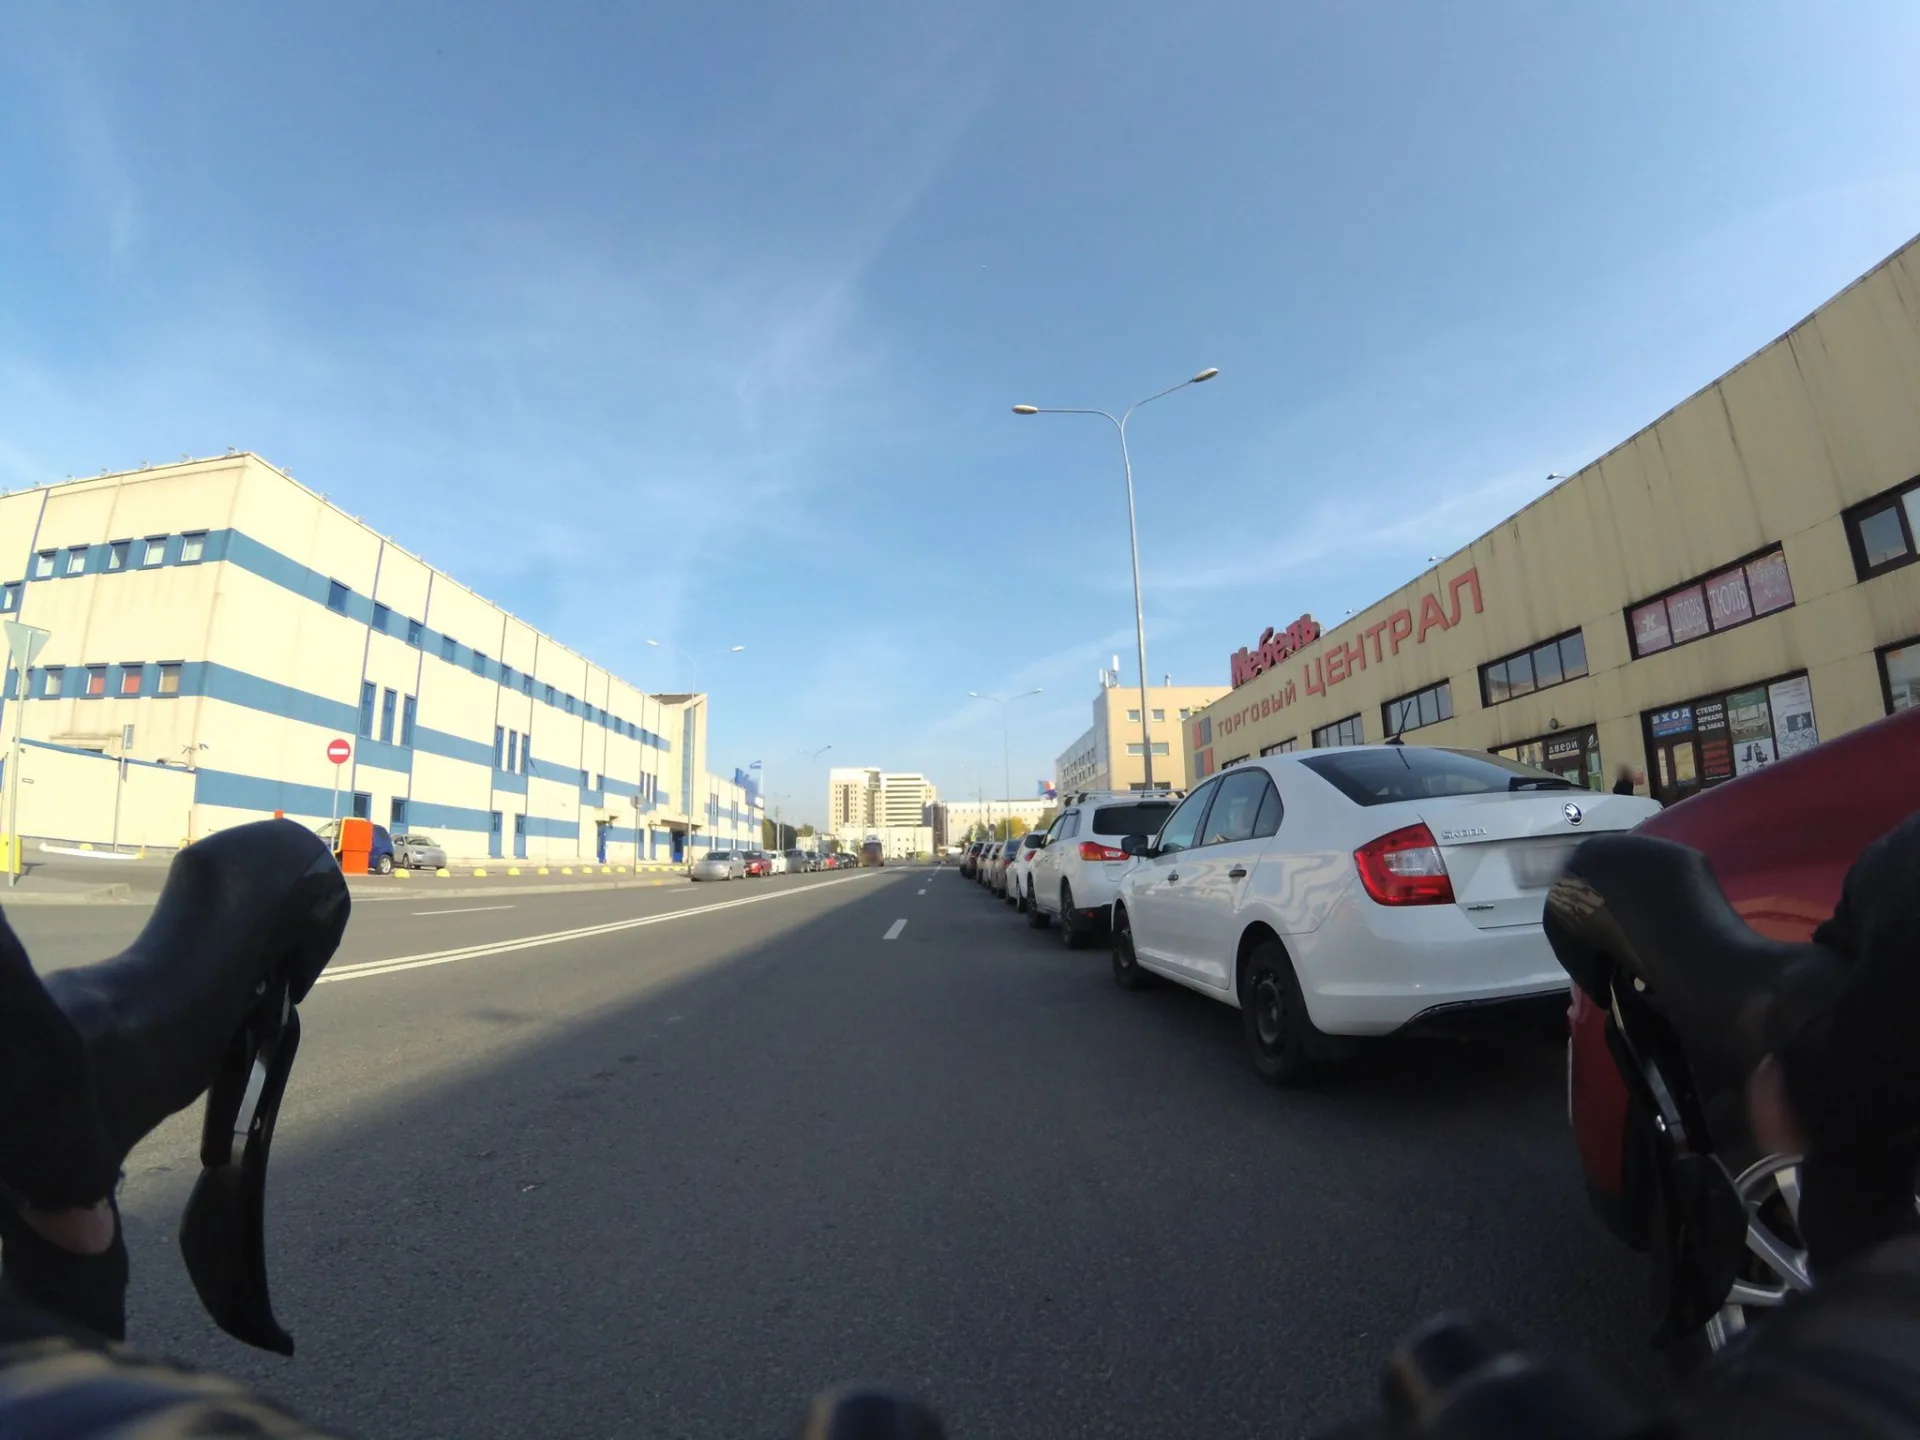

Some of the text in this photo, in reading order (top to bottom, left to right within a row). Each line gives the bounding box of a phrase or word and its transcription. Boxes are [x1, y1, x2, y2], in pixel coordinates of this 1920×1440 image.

[1709, 581, 1748, 619] ТЮЛЬ
[1218, 567, 1484, 738] ТОРГОВЫЙ ЦЕНТРАЛ
[1651, 707, 1692, 725] ВХОД
[1696, 704, 1722, 716] СТЕКЛО
[1697, 713, 1723, 724] ЗЕРКАЛО
[1698, 724, 1707, 732] НА
[1707, 721, 1725, 730] ЗАКАЗ
